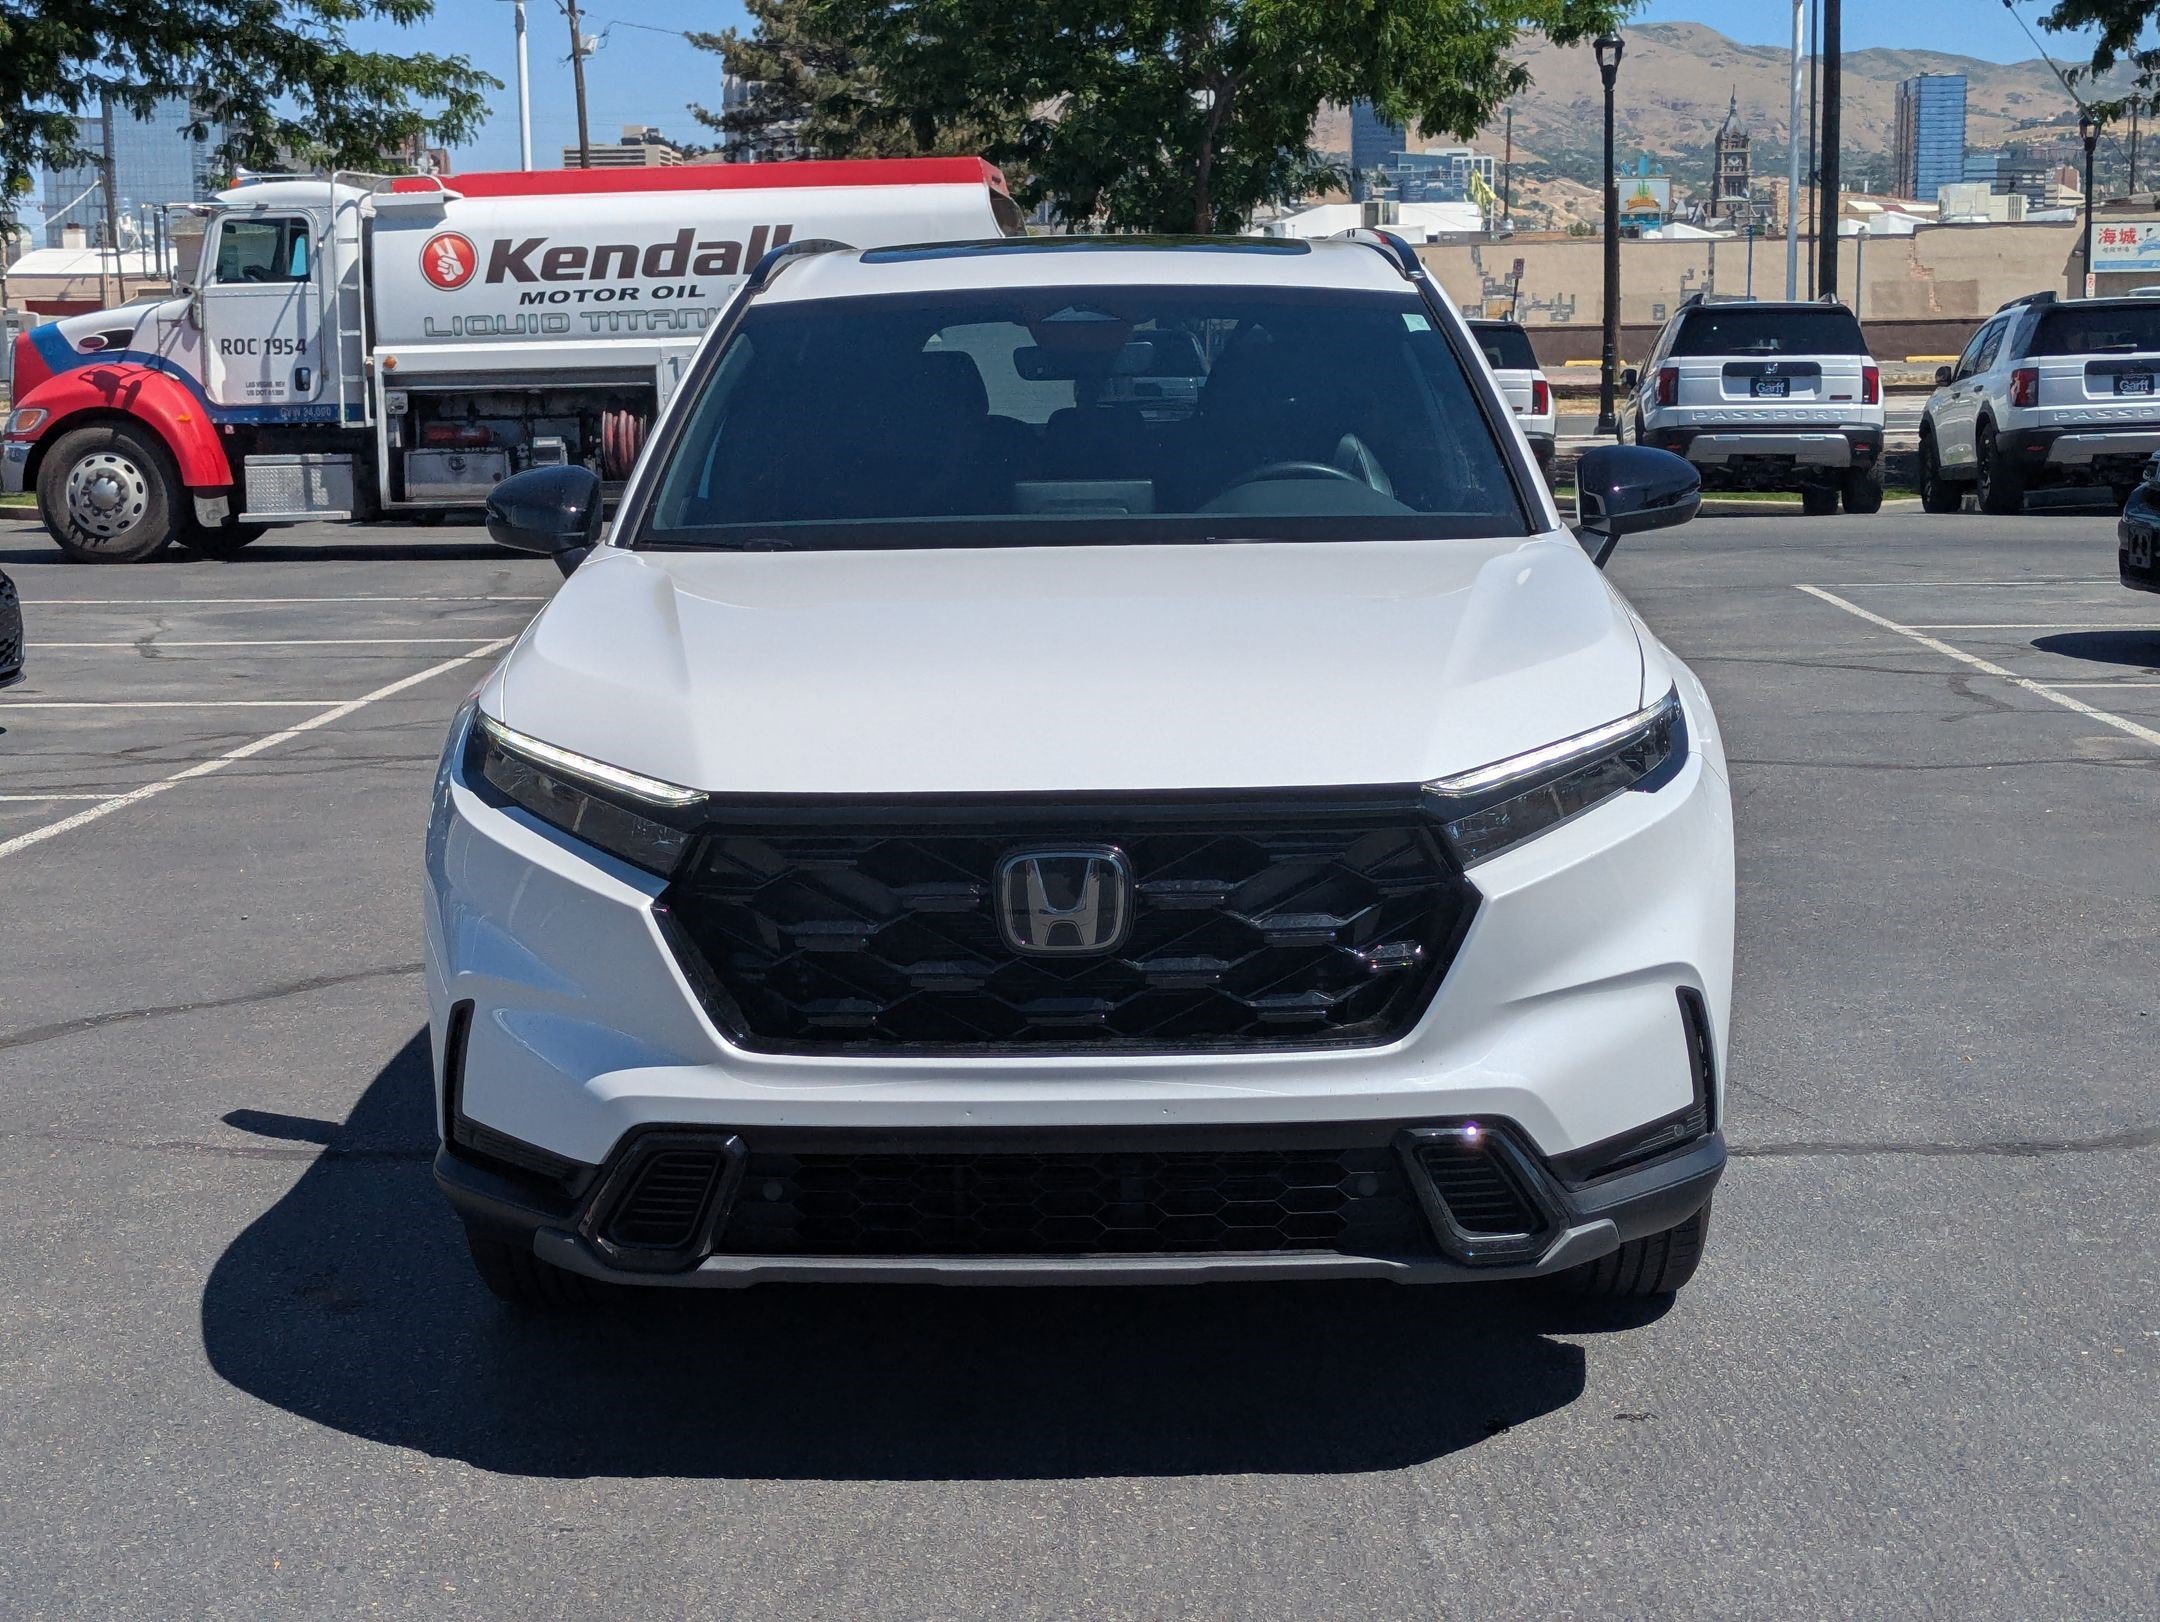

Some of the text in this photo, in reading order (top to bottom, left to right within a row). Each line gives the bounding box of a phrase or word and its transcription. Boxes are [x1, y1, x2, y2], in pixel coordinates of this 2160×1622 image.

[2097, 227, 2137, 245] 海城
[519, 285, 706, 305] MOTOR OIL
[424, 313, 571, 337] LIQUID
[221, 338, 308, 356] ROC 1954
[1756, 382, 1785, 393] Garff
[1691, 411, 1849, 421] PASSPORT
